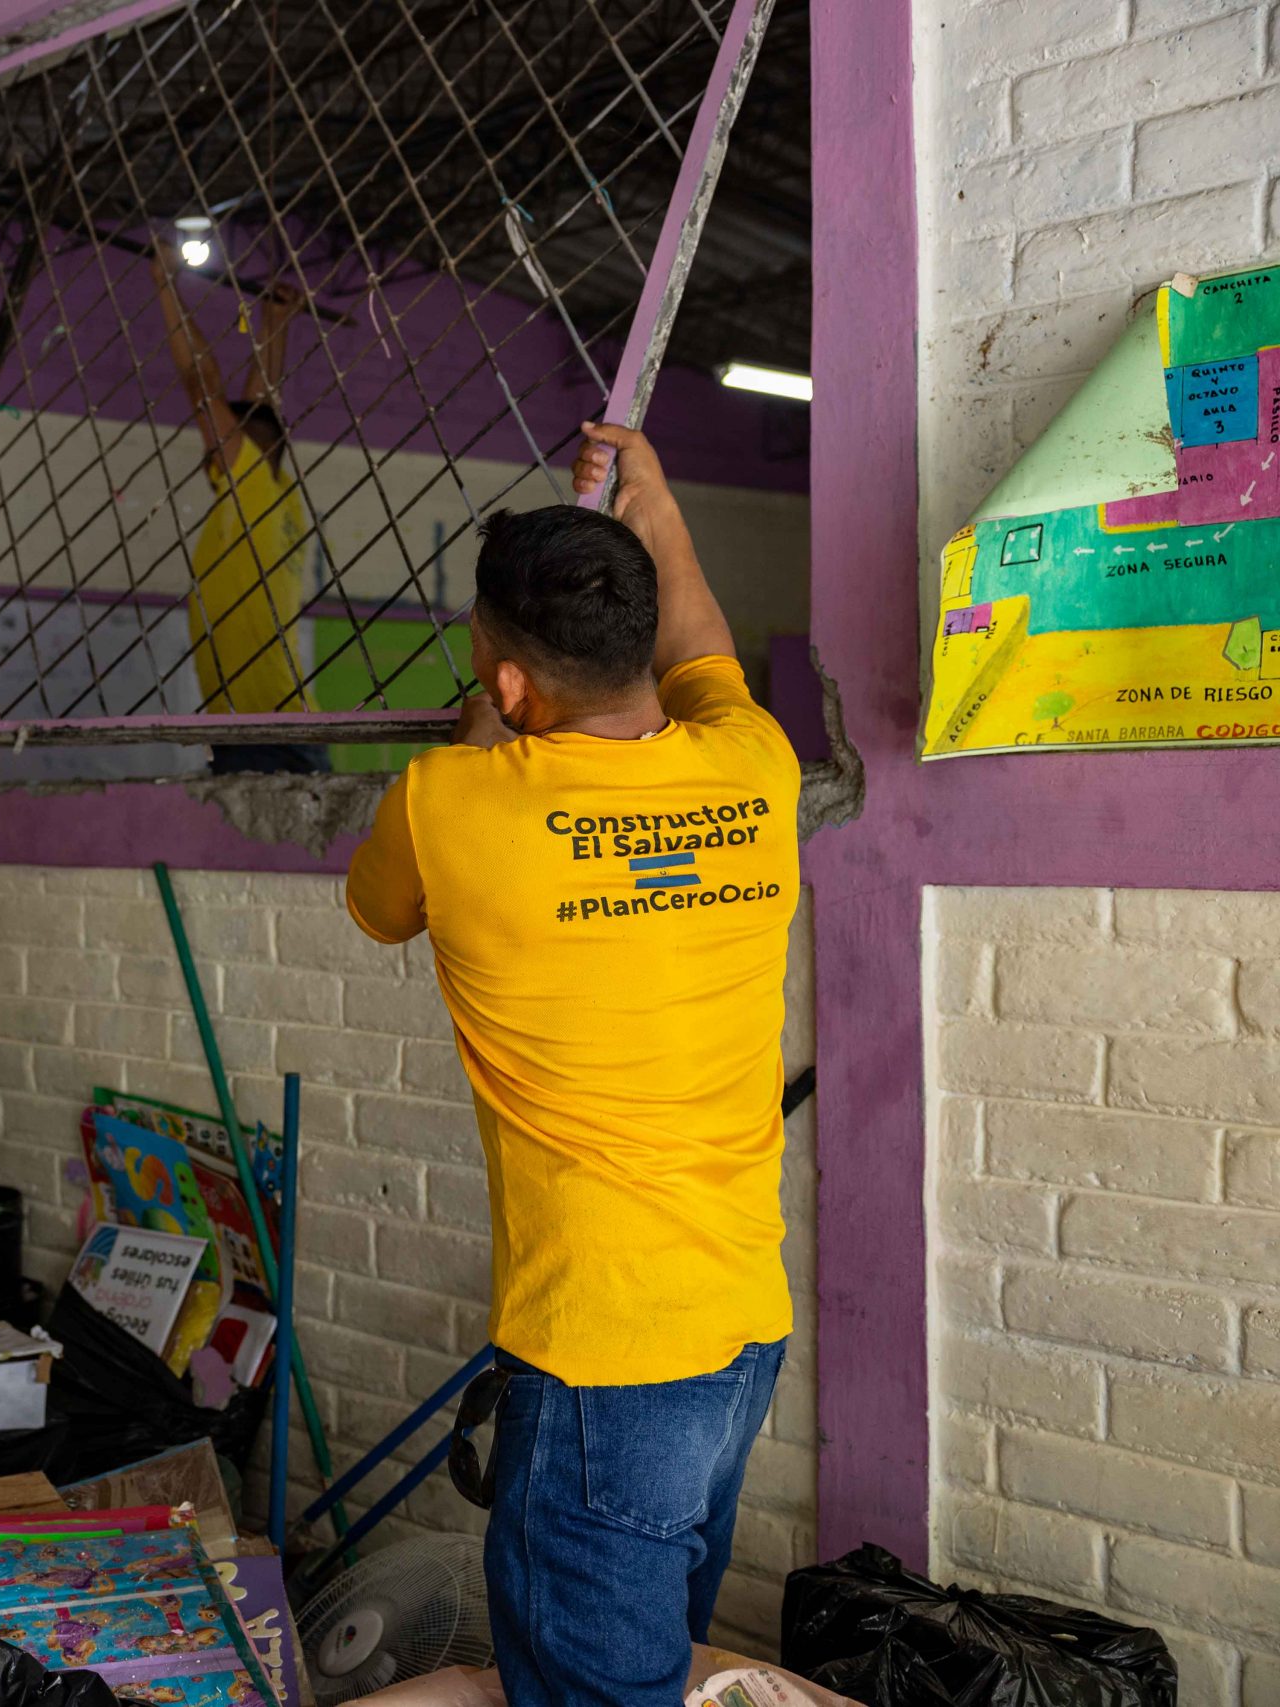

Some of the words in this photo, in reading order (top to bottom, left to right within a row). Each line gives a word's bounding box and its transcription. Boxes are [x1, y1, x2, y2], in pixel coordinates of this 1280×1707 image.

[1203, 275, 1271, 295] CANCHITA
[1234, 292, 1244, 304] 2
[1191, 363, 1245, 378] QUINTO
[1211, 376, 1219, 386] Y
[1188, 386, 1239, 401] OCTAVO
[1203, 403, 1237, 417] AULA
[1214, 420, 1225, 434] 3
[1105, 562, 1150, 578] ZONA
[1163, 553, 1228, 570] SEGURA
[1115, 686, 1164, 703] ZONA
[1171, 686, 1193, 701] DE
[1204, 686, 1273, 703] RIESGO
[1067, 728, 1110, 743] SANTA
[1119, 725, 1185, 741] BARBARA
[546, 797, 770, 835] Constructora
[572, 832, 603, 860] El
[613, 825, 759, 858] Salvador
[556, 881, 780, 923] #PlanCeroOcio
[121, 1244, 191, 1269] escolares
[111, 1265, 151, 1287] útiles
[155, 1274, 180, 1293] tus
[97, 1306, 151, 1336] Recog
